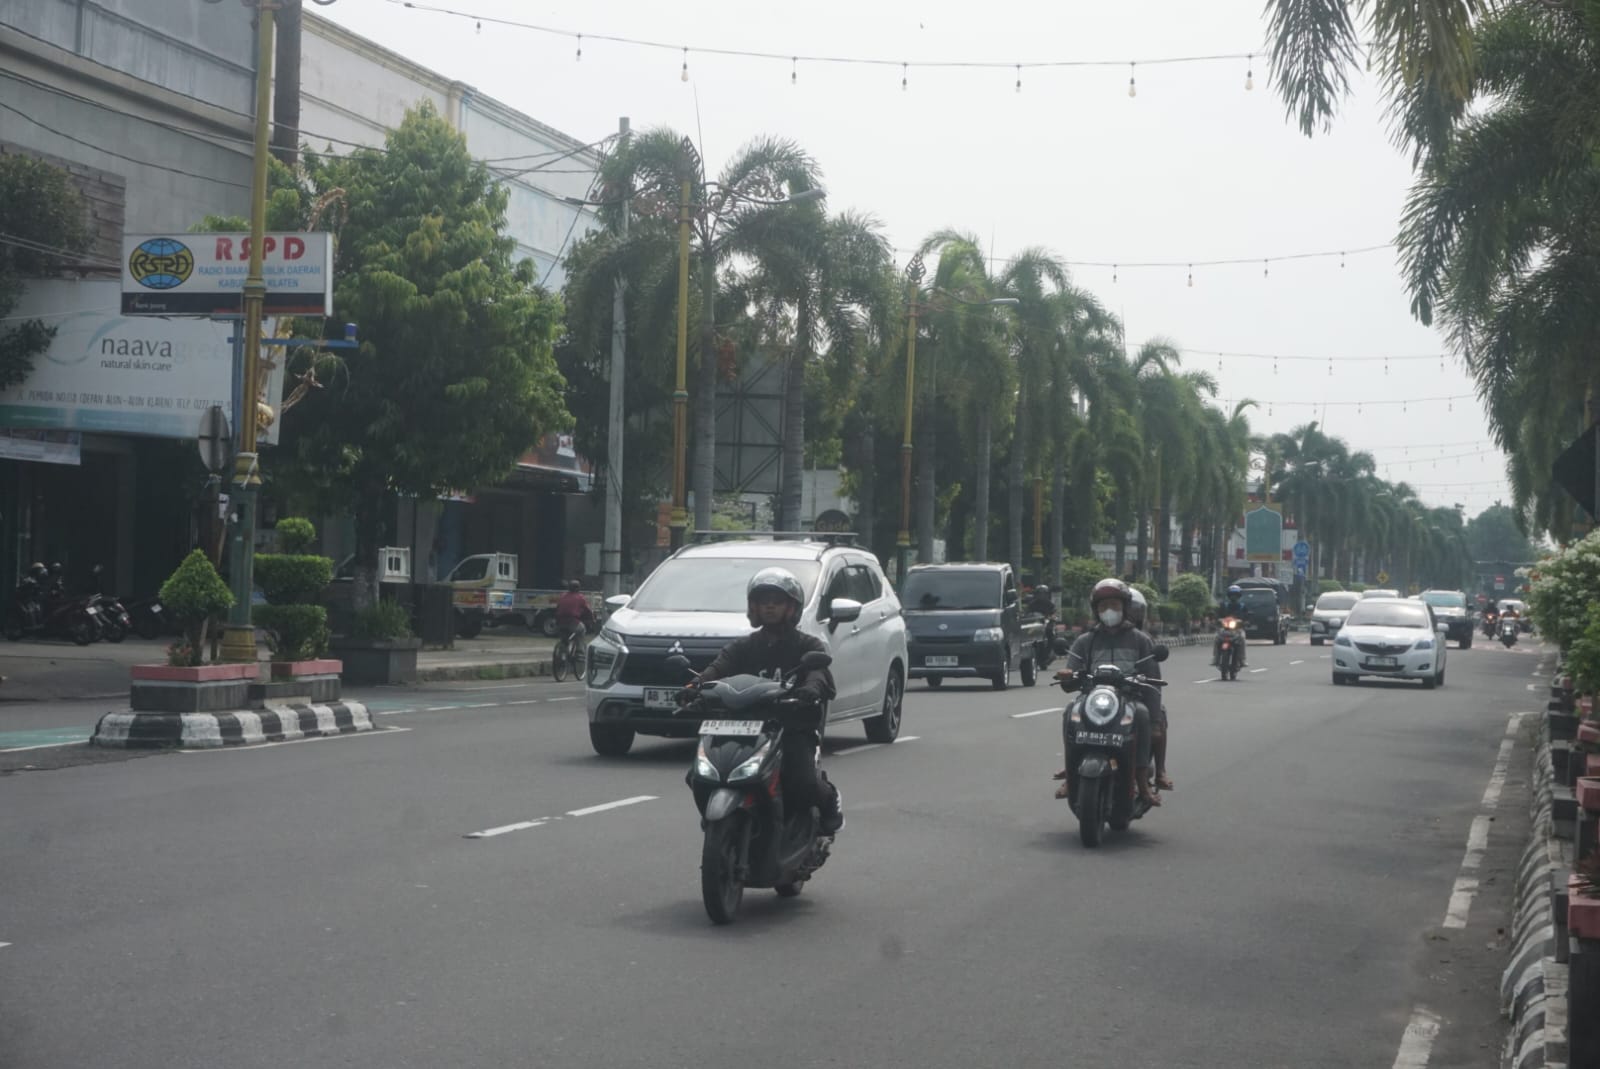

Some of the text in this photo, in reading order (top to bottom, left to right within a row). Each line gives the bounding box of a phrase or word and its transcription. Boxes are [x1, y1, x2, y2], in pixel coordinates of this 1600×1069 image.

[215, 236, 305, 261] RSPD
[198, 266, 223, 275] RADIO
[225, 266, 249, 275] SIARA
[287, 265, 320, 275] DAERAH
[101, 359, 172, 371] natural skin care
